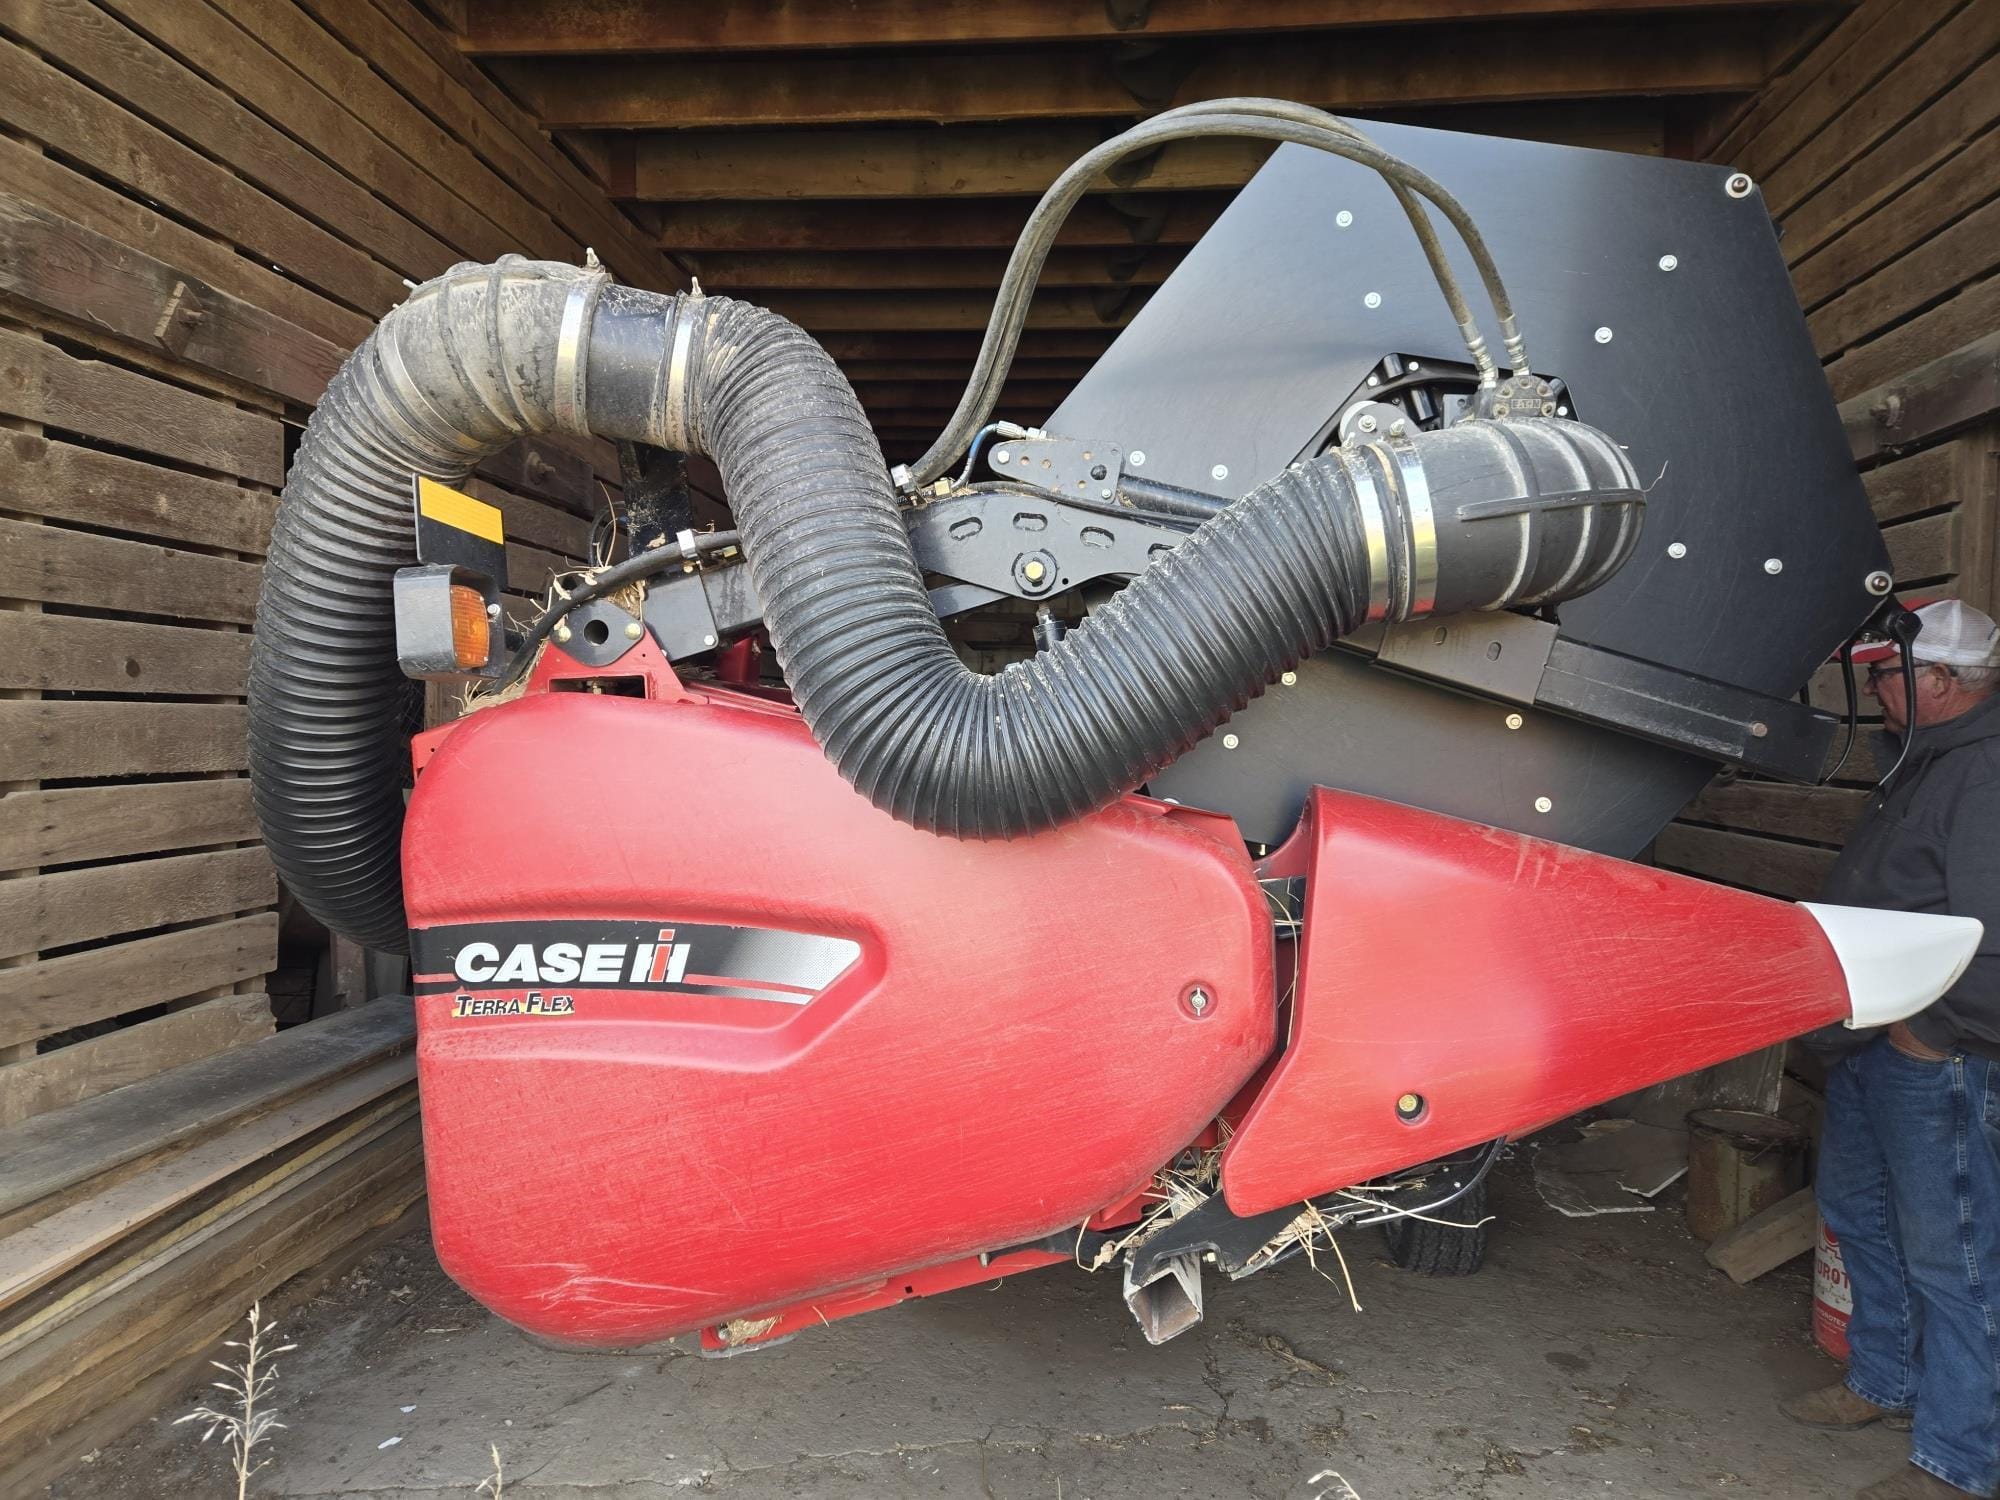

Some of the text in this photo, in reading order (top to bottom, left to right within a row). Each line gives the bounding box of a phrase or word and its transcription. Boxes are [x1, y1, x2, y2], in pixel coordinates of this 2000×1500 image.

[455, 942, 627, 983] CASE
[456, 992, 575, 1016] TERRA FLEX
